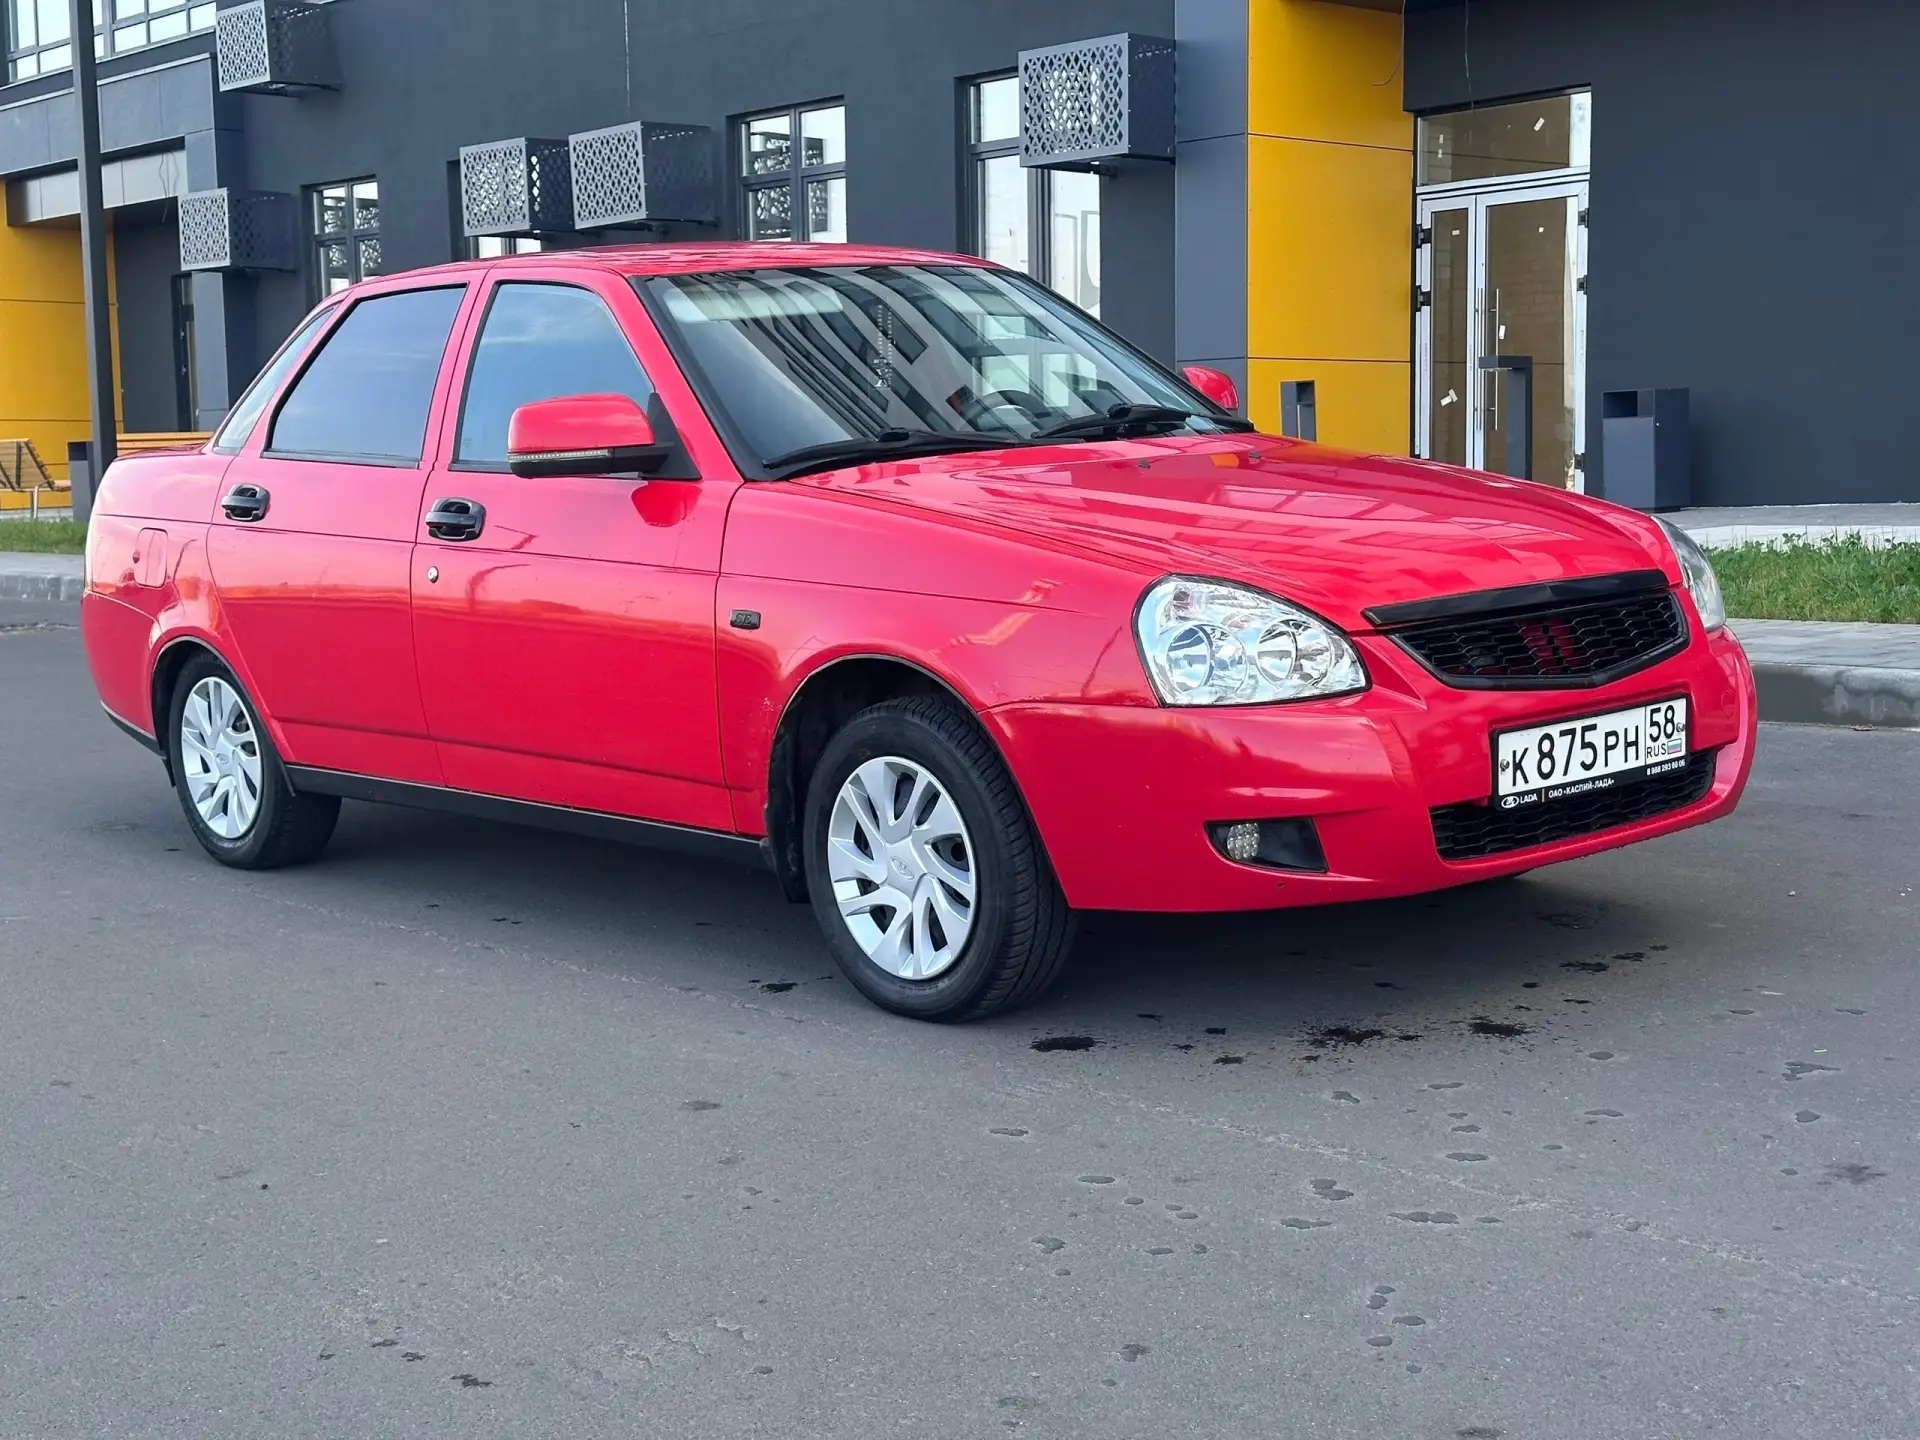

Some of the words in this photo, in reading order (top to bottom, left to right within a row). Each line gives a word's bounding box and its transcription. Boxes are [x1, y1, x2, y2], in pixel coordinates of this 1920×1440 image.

[1649, 704, 1676, 743] 58
[1646, 743, 1667, 759] RUS
[1520, 793, 1538, 804] LADA
[1548, 788, 1563, 799] ОАО
